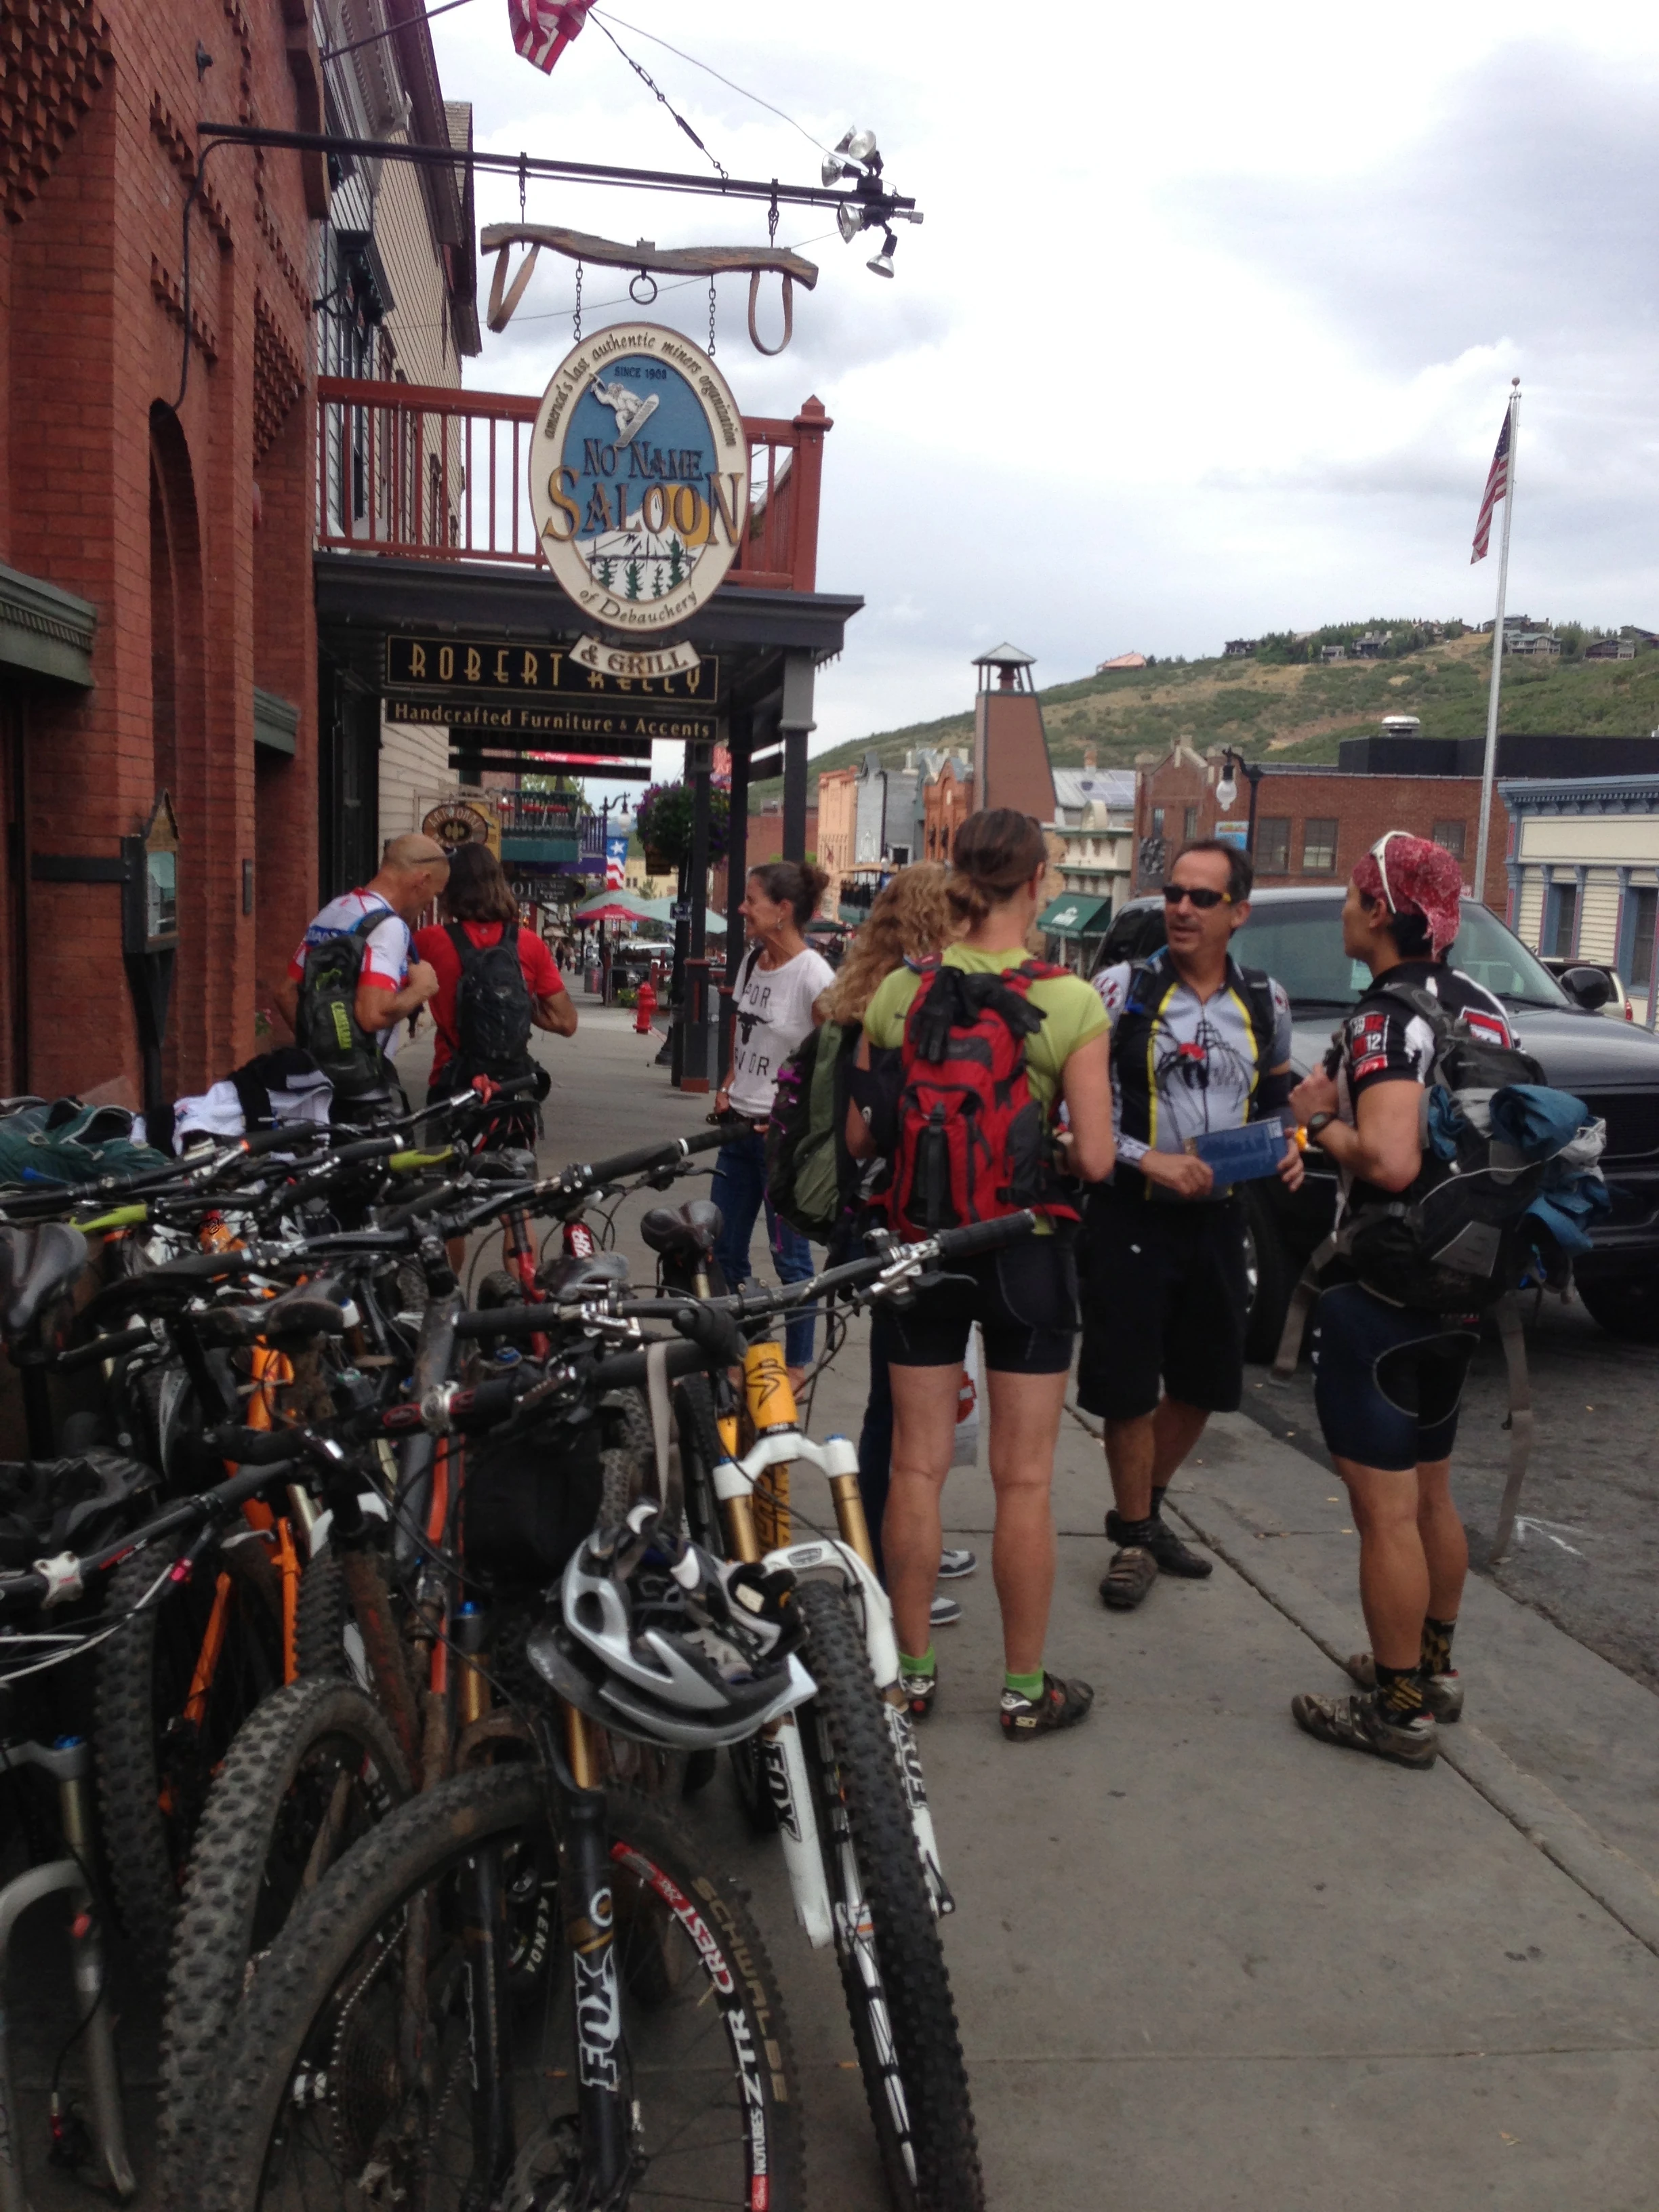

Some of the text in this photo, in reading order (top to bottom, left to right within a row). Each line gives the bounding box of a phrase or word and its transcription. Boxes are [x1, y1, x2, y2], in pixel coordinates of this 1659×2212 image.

[544, 332, 737, 447] america's last authentic miners organization
[614, 366, 641, 378] SINCE
[583, 438, 703, 481] NO NAME
[541, 464, 745, 546] SALOON
[579, 588, 699, 624] of Debauchery
[408, 642, 563, 687] ROBERT
[580, 644, 689, 673] & GRILL
[394, 703, 512, 726] Handcrafted
[520, 711, 613, 732] Furniture
[634, 718, 710, 737] Accents
[674, 1906, 734, 1994] CREST
[573, 1944, 621, 2093] FOX
[727, 2009, 764, 2108] ZTR
